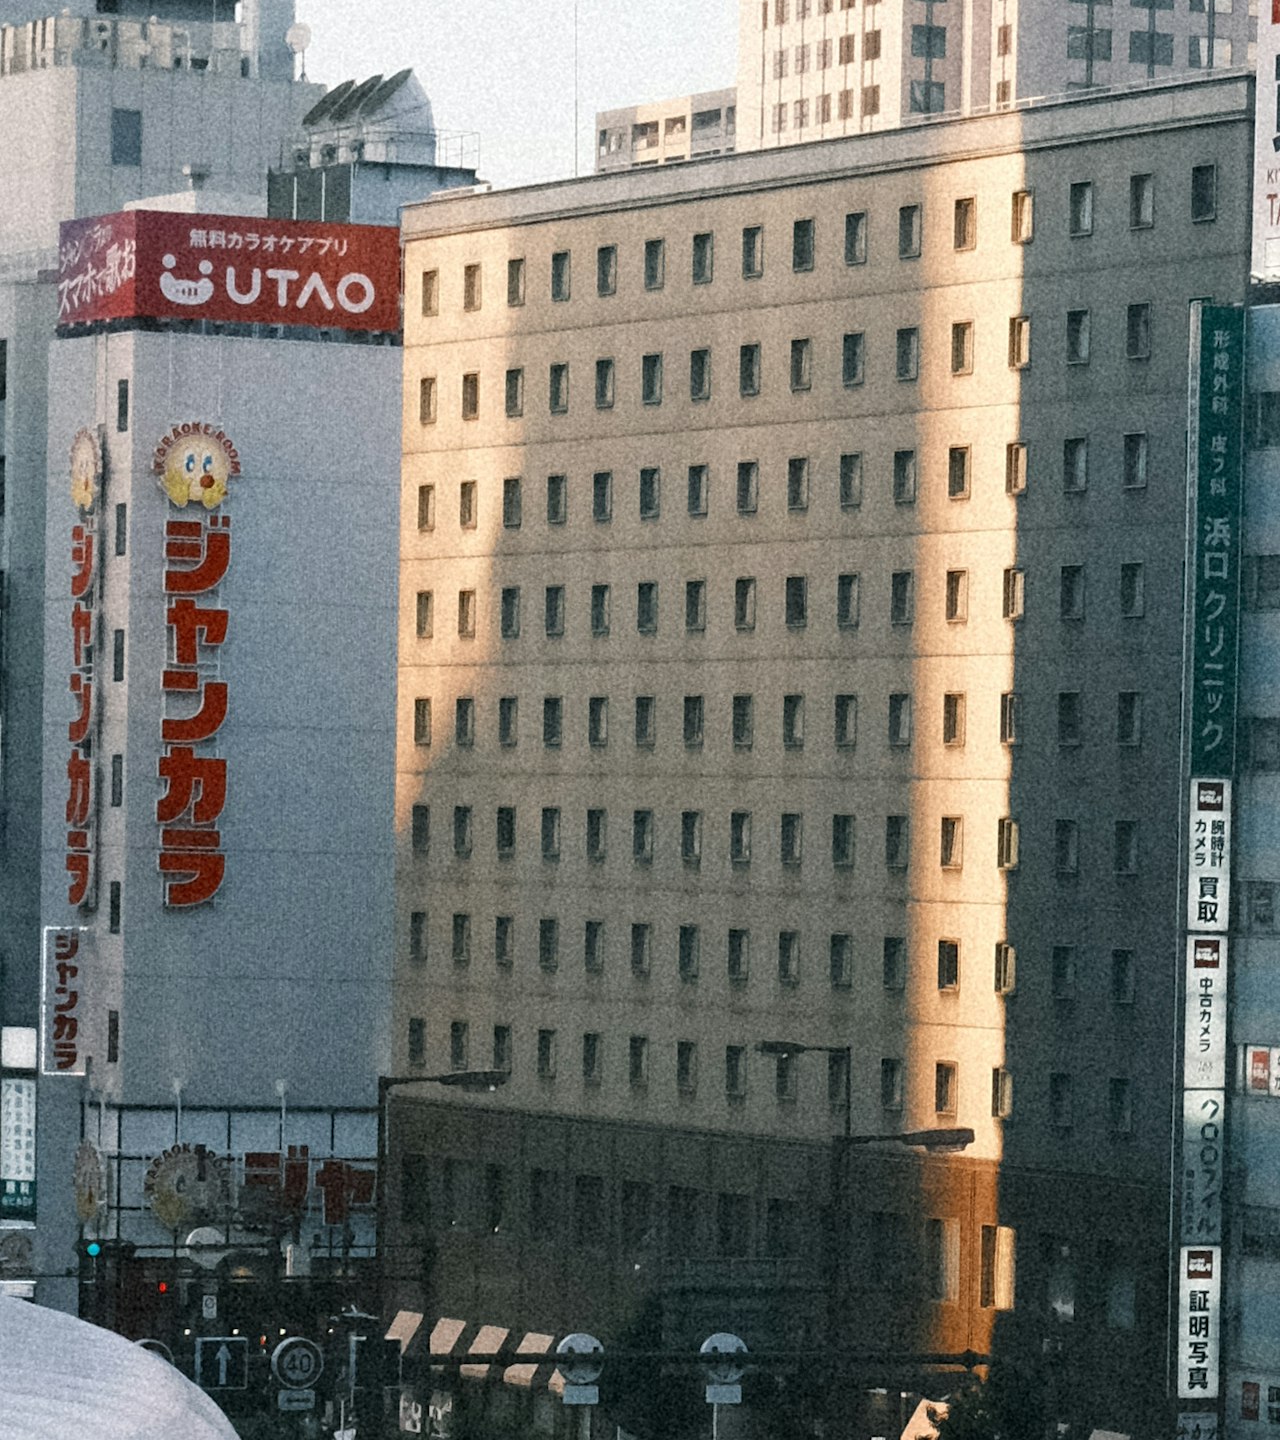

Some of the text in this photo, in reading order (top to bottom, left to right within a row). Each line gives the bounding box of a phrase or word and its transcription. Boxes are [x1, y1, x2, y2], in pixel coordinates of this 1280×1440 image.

[189, 228, 349, 257] 無料カラオケアプリ
[225, 265, 376, 314] UTAO
[157, 515, 230, 906] ジャンカラ
[1194, 819, 1207, 867] カメラ
[1197, 877, 1219, 923] 買取
[1199, 977, 1214, 1053] 中古カメラ
[1188, 1289, 1210, 1391] 証明写真
